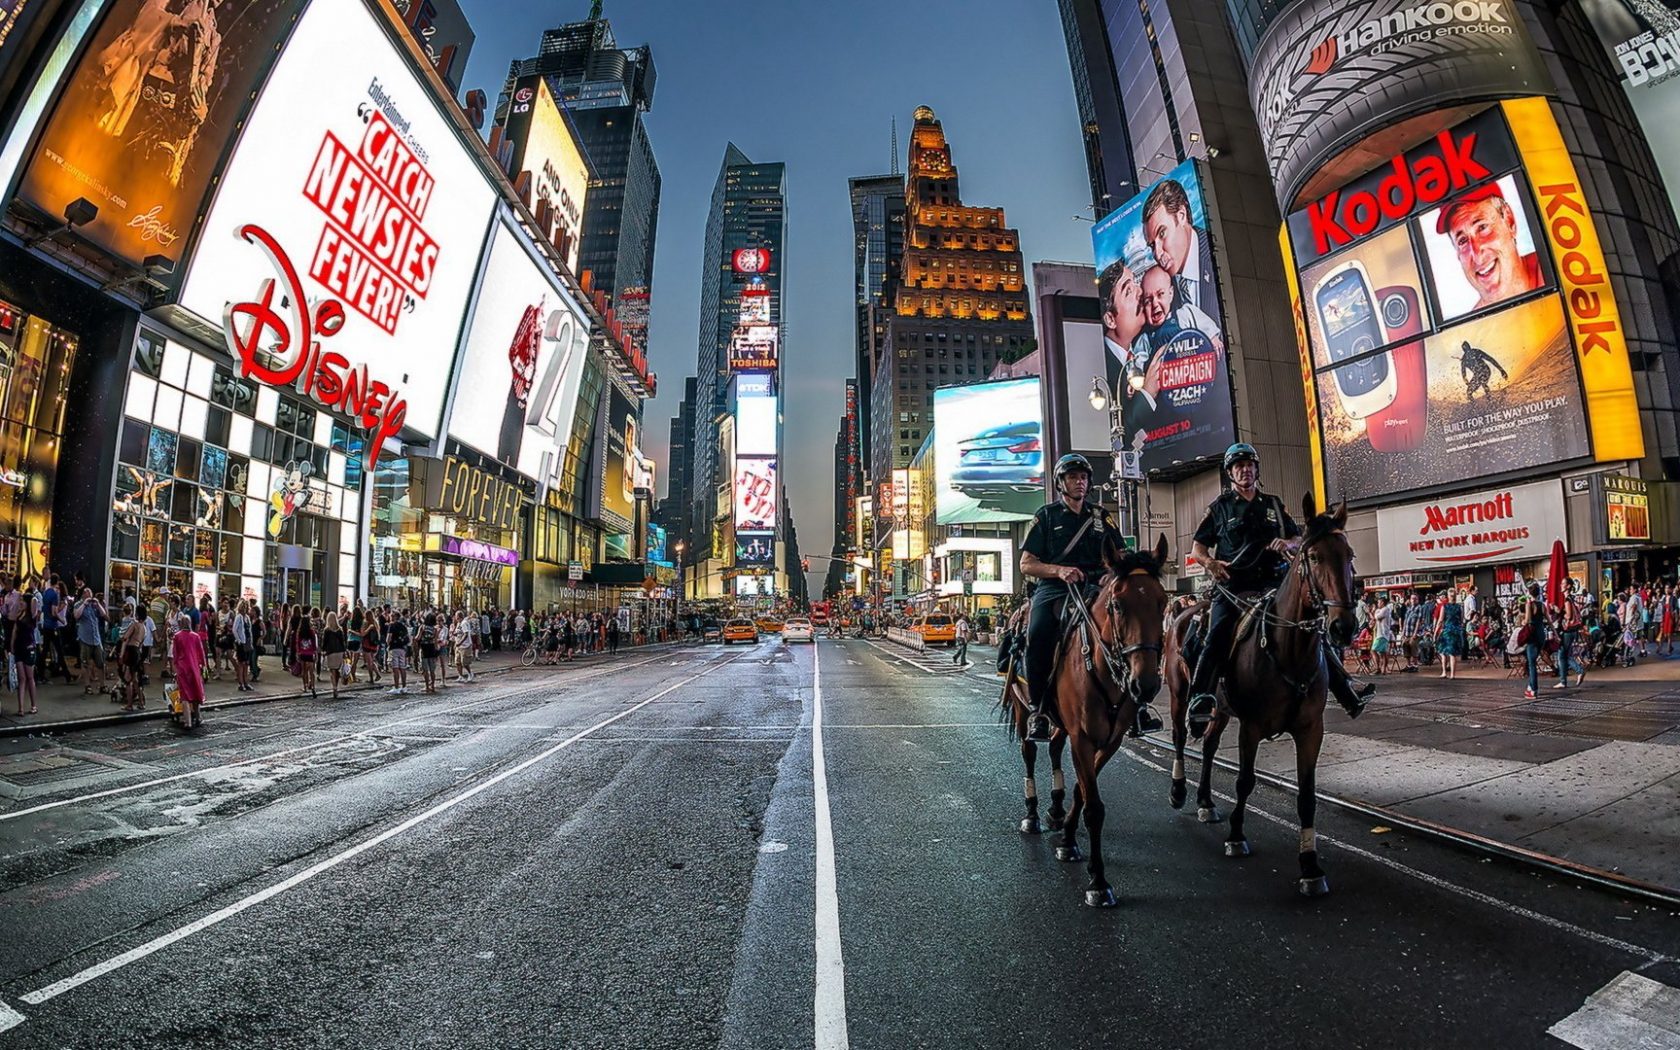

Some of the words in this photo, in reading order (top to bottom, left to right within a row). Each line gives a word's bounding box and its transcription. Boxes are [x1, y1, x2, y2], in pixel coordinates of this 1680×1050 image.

[1371, 28, 1432, 56] driving
[1438, 22, 1512, 38] emotion
[1614, 41, 1630, 56] JON
[368, 76, 411, 135] Entertainment
[513, 104, 530, 113] LG
[543, 158, 560, 194] AND
[561, 188, 580, 226] ONLY
[1307, 129, 1493, 255] Kodak
[305, 136, 439, 299] NEWSIES
[745, 283, 766, 291] 2012
[1538, 183, 1618, 361] Kodak
[1173, 338, 1200, 354] WILL
[731, 359, 777, 367] TOSHIBA
[1162, 360, 1213, 388] CAMPAIGN
[1292, 295, 1318, 433] Kodak
[1173, 385, 1201, 401] ZACH
[1146, 421, 1180, 442] AUGUST
[1180, 419, 1191, 431] 10
[1444, 421, 1469, 434] BUILT
[1467, 416, 1484, 429] FOR
[1484, 412, 1502, 425] THE
[1502, 406, 1523, 420] WAY
[1522, 401, 1544, 415] YOU
[440, 456, 523, 531] FOREVER
[1604, 477, 1648, 493] MARQUIS
[1420, 491, 1513, 536] Marriott
[1409, 540, 1435, 553] NEW
[1437, 534, 1470, 548] YORK
[1471, 527, 1530, 544] MARQUIS
